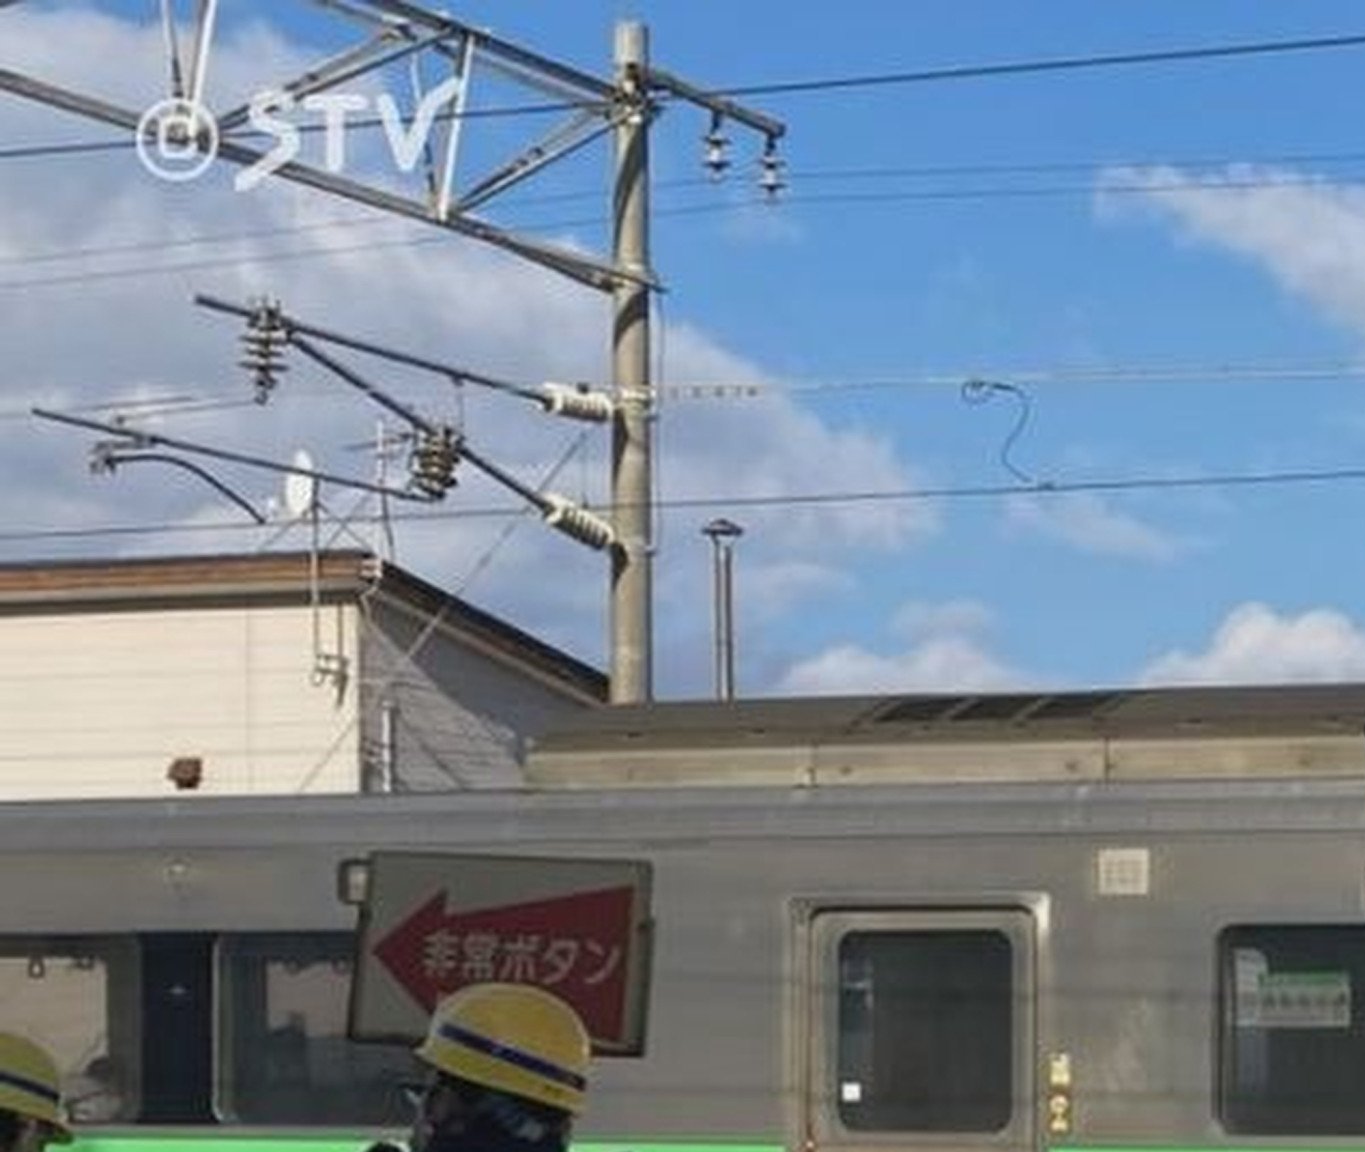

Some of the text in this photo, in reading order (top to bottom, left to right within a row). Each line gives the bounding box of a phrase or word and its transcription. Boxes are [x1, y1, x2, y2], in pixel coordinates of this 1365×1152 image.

[421, 929, 620, 985] 非常ボタン
